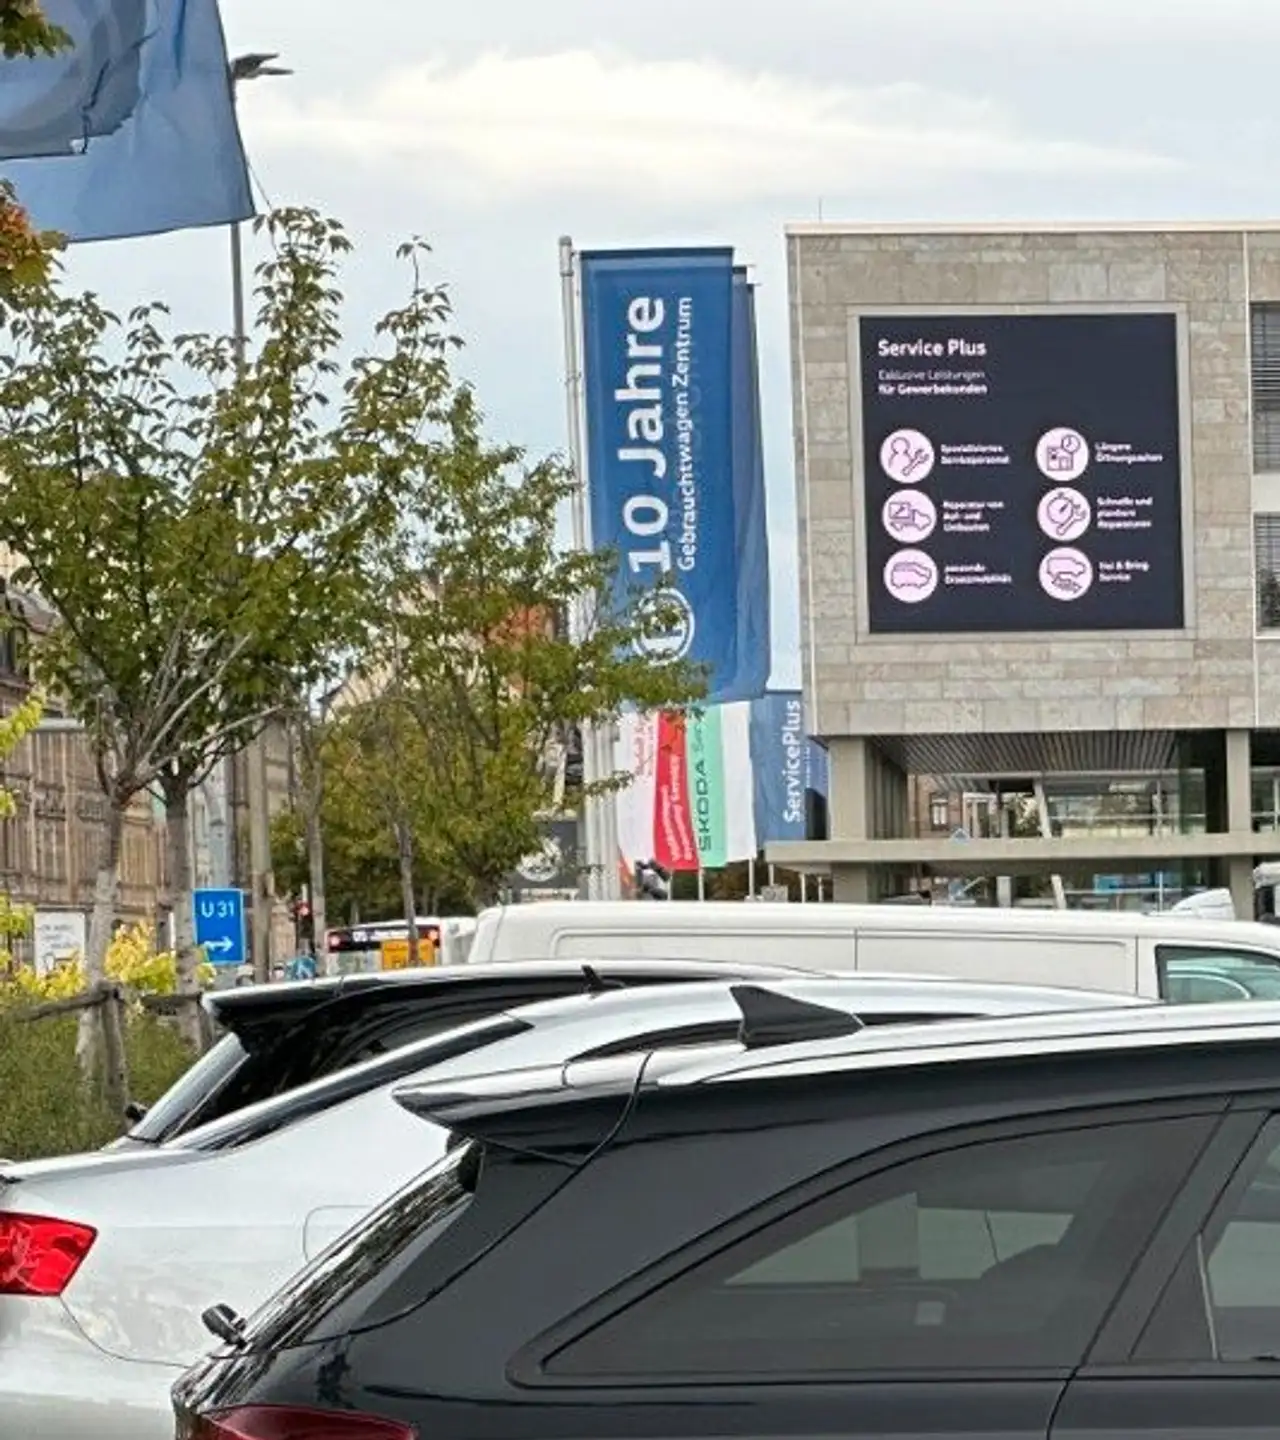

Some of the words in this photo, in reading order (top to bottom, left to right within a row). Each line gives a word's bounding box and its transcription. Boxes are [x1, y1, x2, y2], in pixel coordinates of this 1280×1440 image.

[671, 297, 692, 387] Zentrum
[878, 338, 944, 356] Service
[948, 338, 987, 356] Plus
[614, 296, 667, 477] Jahre
[672, 389, 696, 571] Gebrauchtwagen
[623, 495, 671, 575] 10
[201, 900, 214, 918] U
[217, 900, 234, 918] 31
